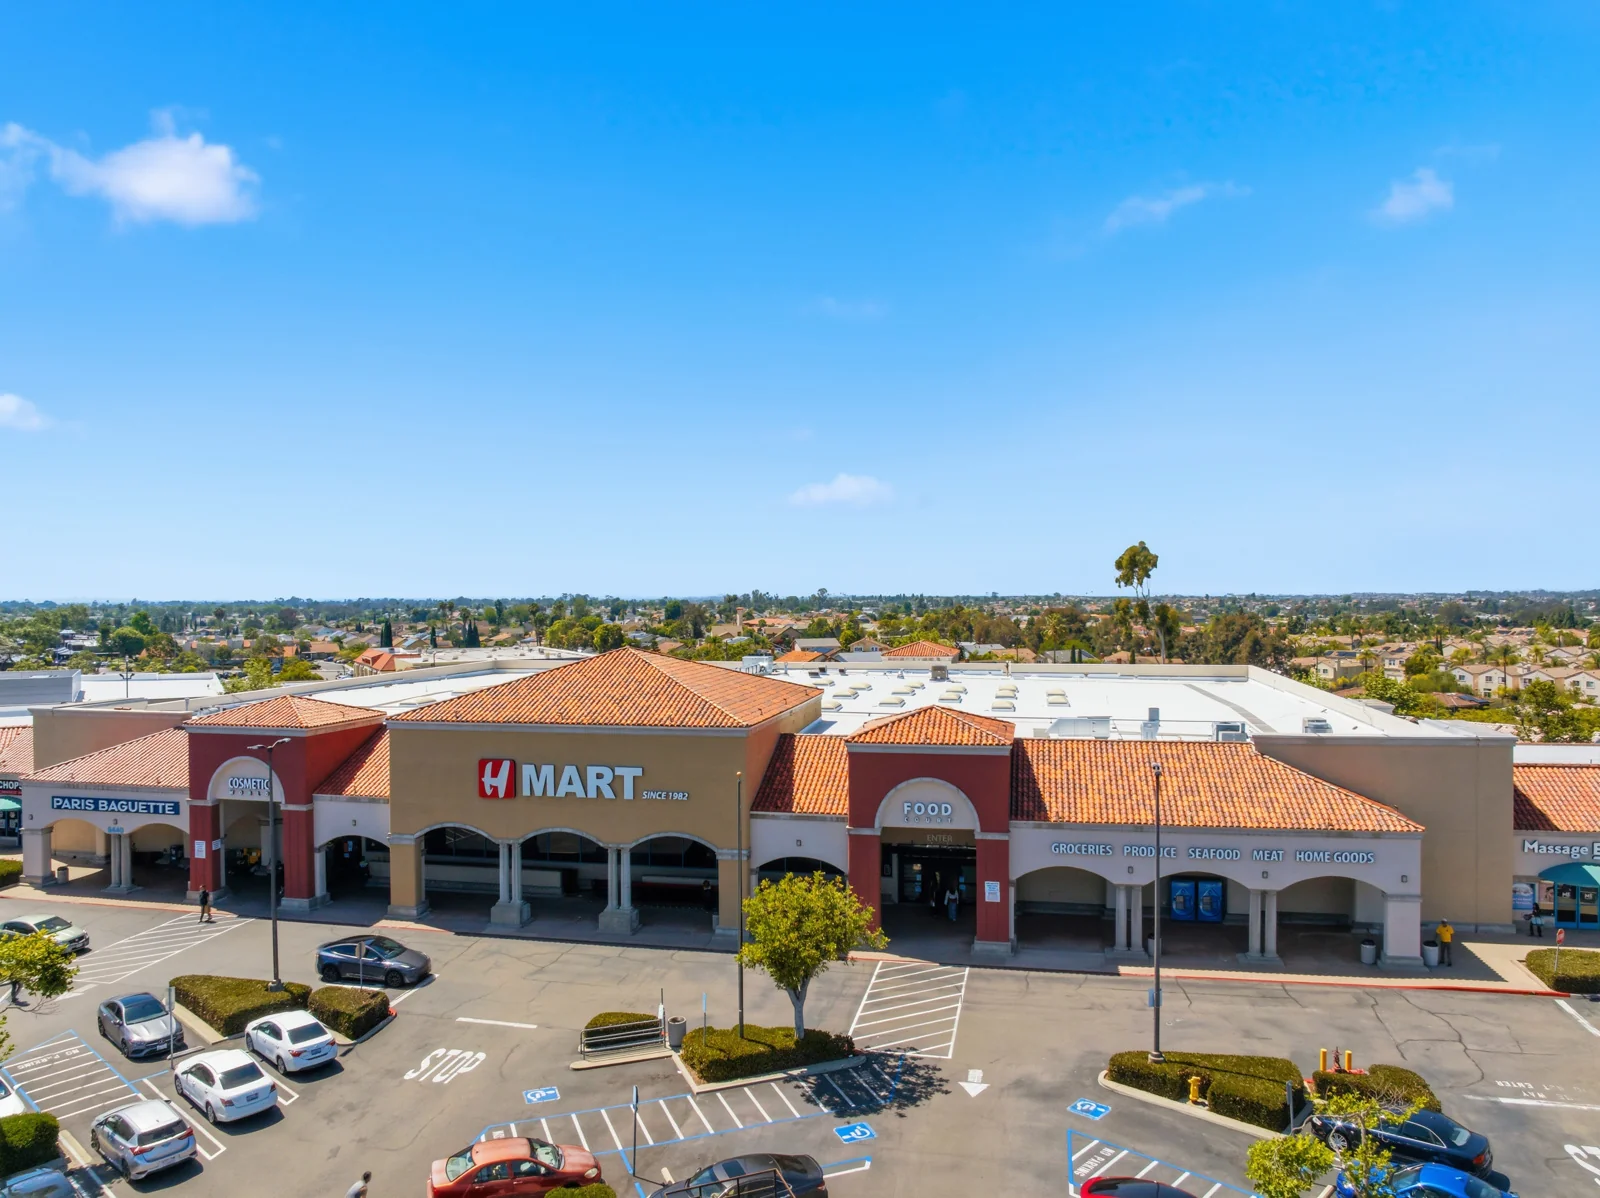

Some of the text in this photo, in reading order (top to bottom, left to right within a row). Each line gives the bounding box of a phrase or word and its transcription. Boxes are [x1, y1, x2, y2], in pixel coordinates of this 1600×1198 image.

[0, 781, 22, 790] CHOP
[228, 777, 270, 790] COSMETIC
[482, 760, 643, 800] H MART
[642, 791, 689, 801] SINCE 1982
[53, 797, 175, 815] PARIS BAGUETTE
[903, 802, 953, 816] FOOD
[926, 834, 953, 842] ENTER
[1051, 842, 1114, 856] GROCERIES
[1188, 848, 1241, 861] SEAFOOD
[1252, 849, 1285, 862] MEAT
[1296, 850, 1331, 864] HOME
[1333, 851, 1375, 864] GOODS
[1523, 840, 1589, 859] Massage
[403, 1047, 487, 1084] STOP
